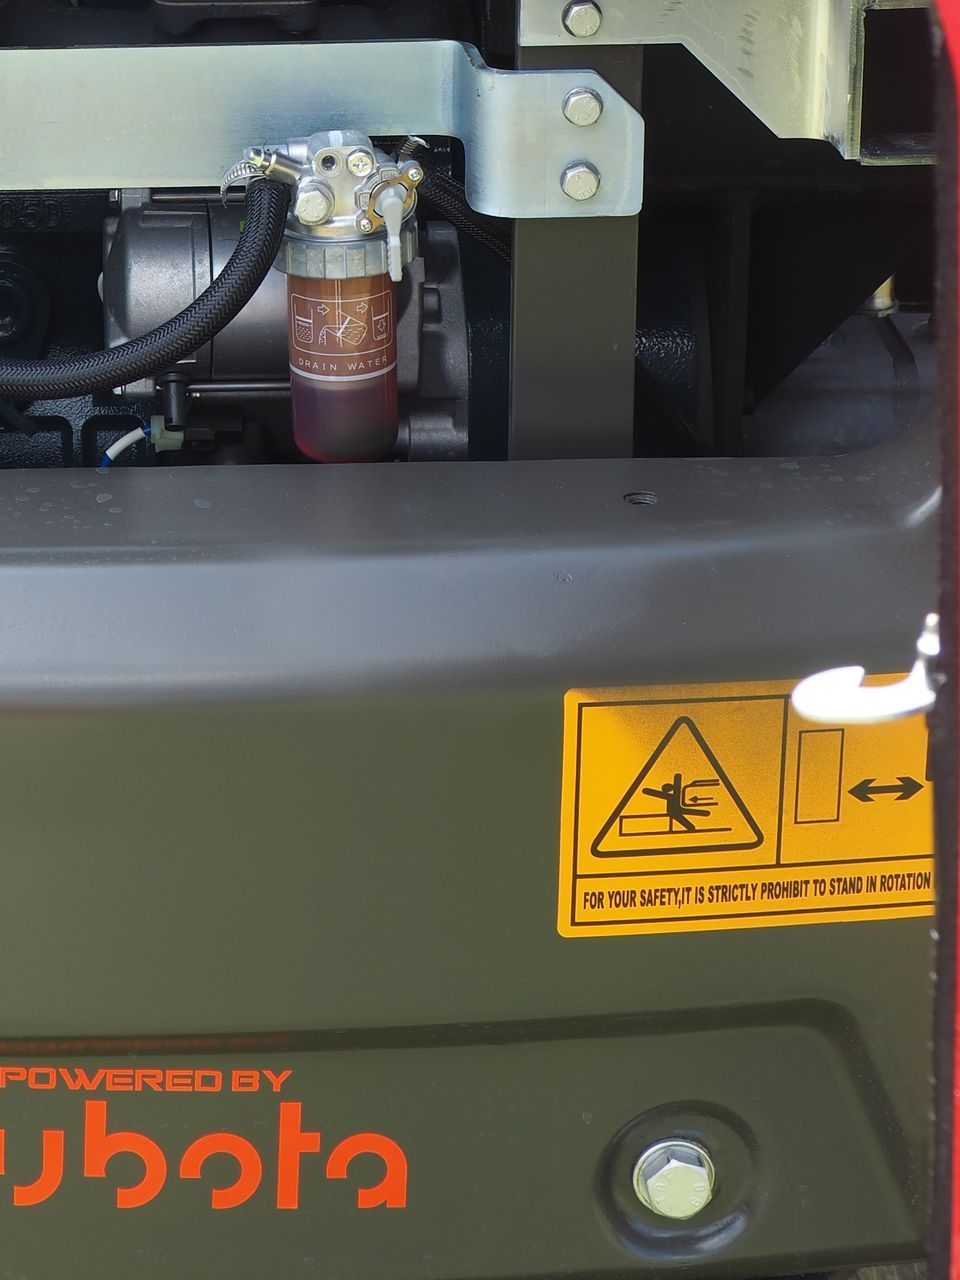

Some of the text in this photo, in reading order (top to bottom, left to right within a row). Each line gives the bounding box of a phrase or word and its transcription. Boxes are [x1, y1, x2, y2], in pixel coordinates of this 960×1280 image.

[298, 355, 388, 371] DRAIN WATER
[583, 871, 931, 910] FOR YOUR SAFETY,IT IS STRICTLY PROHIBIT TO STAND IN ROTATION
[0, 1066, 293, 1092] POWERED BY
